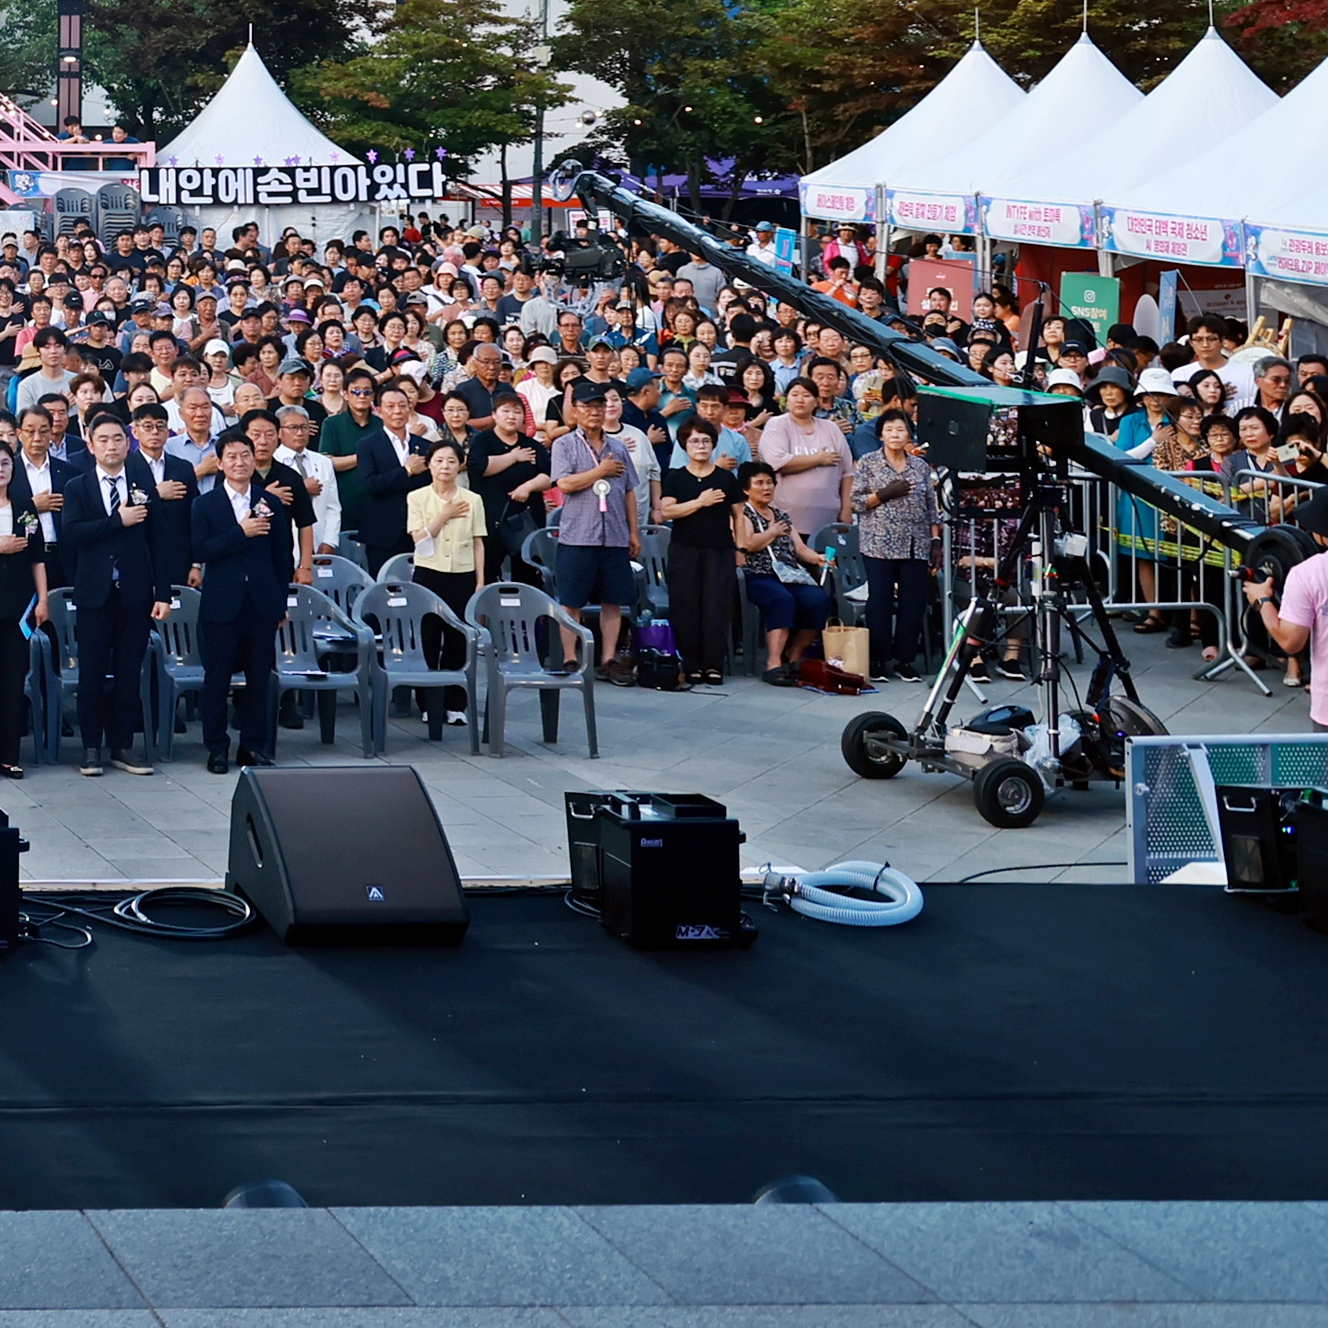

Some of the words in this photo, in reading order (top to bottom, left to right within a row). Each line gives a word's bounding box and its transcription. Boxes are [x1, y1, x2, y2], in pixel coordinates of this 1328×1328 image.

[141, 162, 446, 204] 내안에손빈아있다
[1127, 216, 1153, 235] 대한민국
[1155, 219, 1169, 237] 태백
[1170, 221, 1184, 238] 국제
[1186, 222, 1208, 241] 청소년
